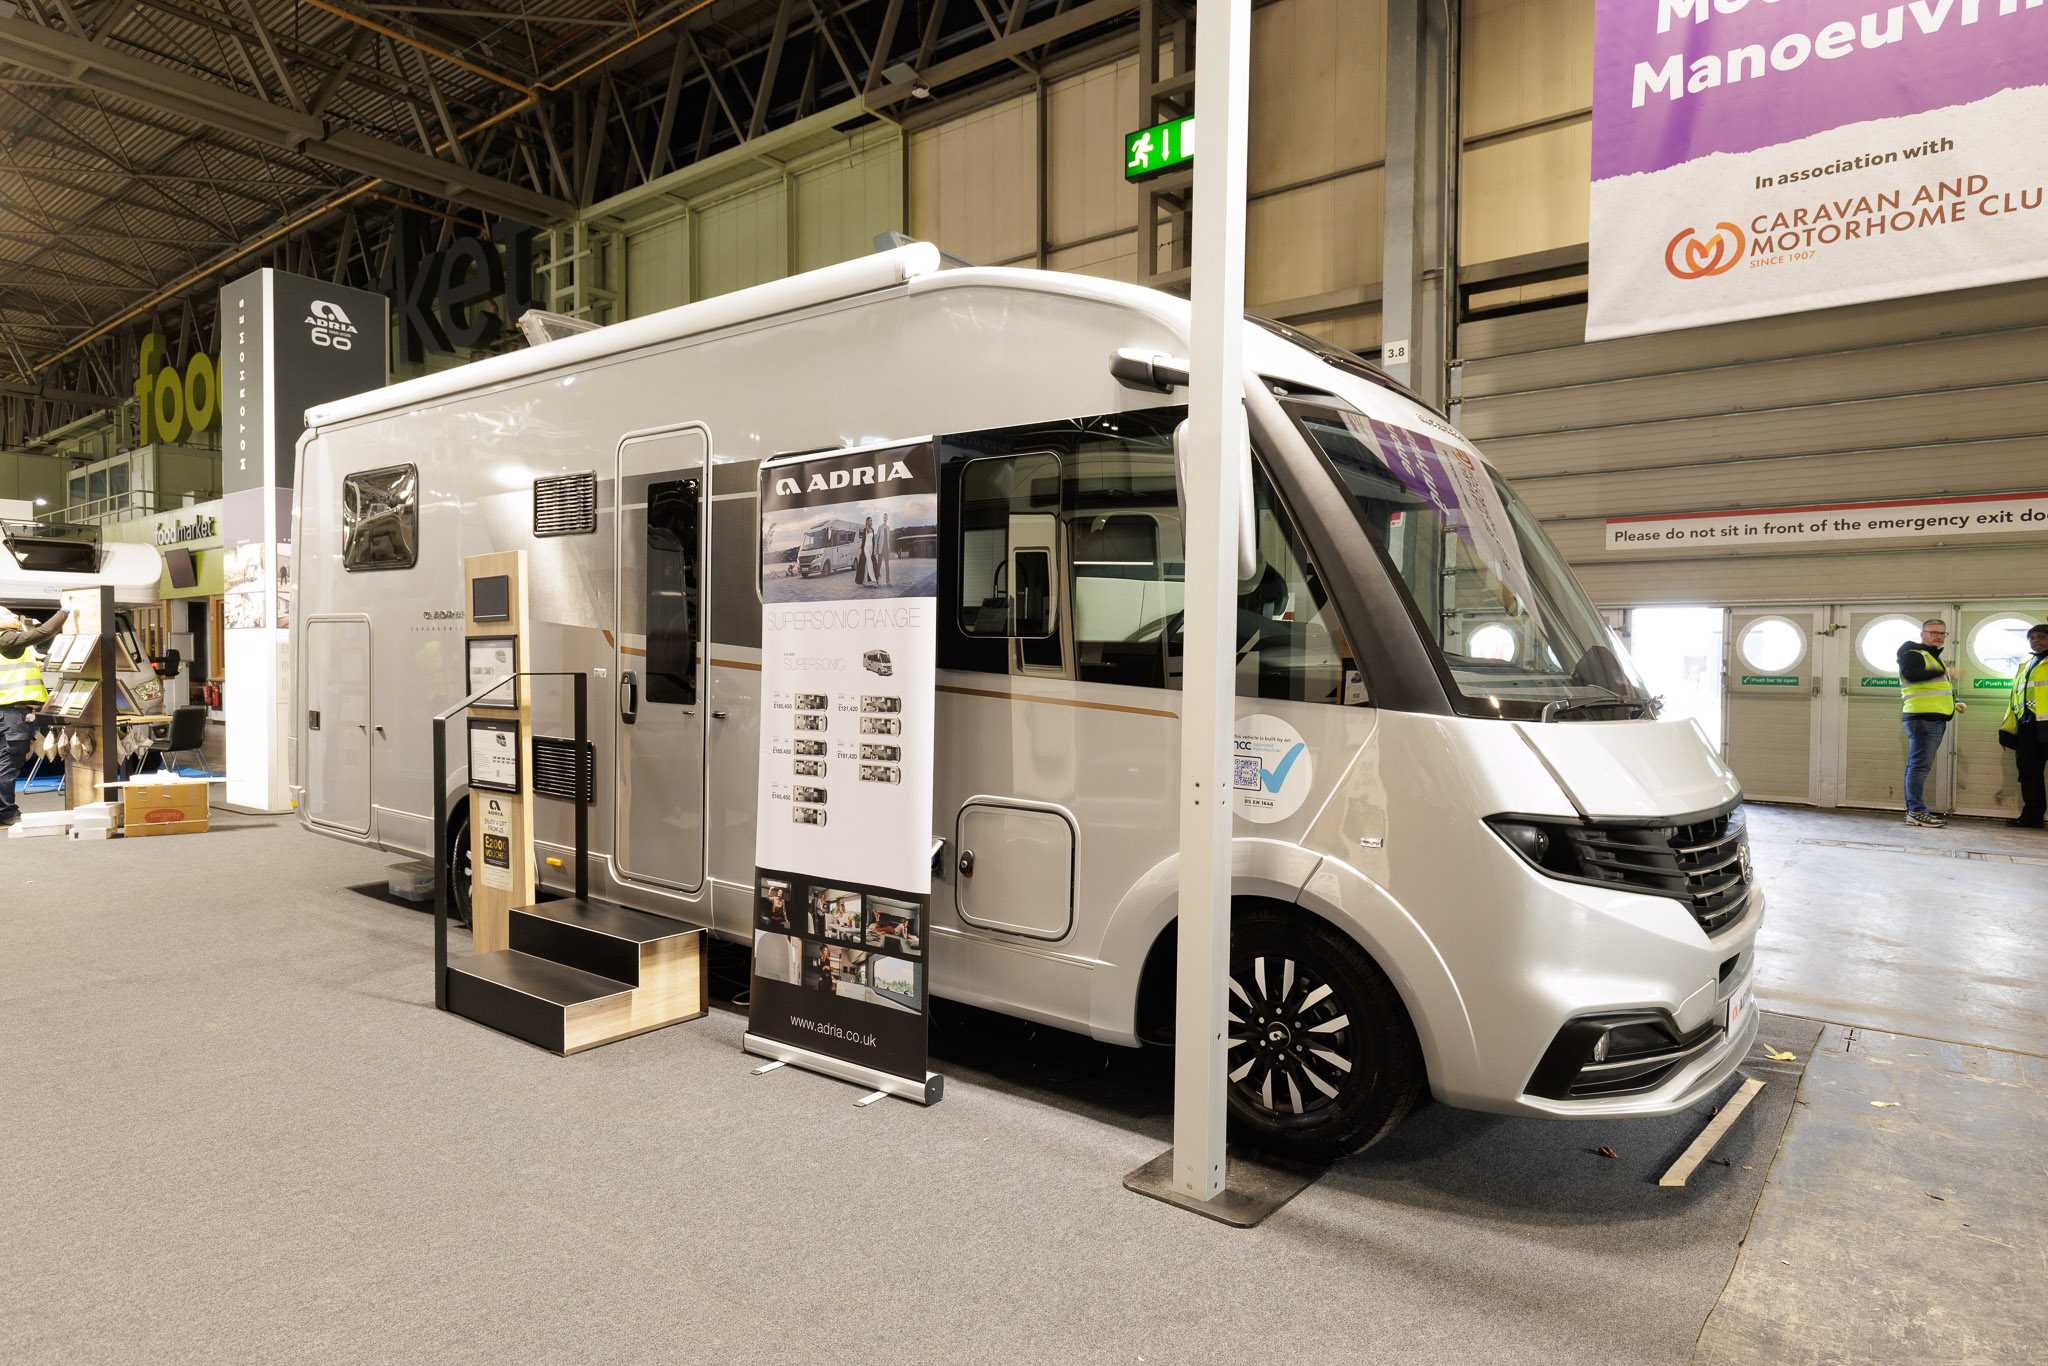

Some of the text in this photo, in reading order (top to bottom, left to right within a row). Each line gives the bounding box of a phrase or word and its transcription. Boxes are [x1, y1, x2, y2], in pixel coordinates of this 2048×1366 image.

[1755, 137, 1954, 189] In association with
[1751, 174, 1988, 234] CARAVAN AND
[1750, 200, 1966, 257] MOTORHOME
[1750, 250, 1816, 268] SINCE 1907
[304, 316, 358, 334] ADRIA
[311, 326, 352, 351] 60
[1387, 347, 1405, 359] 3.8
[135, 332, 222, 446] foo
[238, 298, 247, 471] MOTORHOMES
[806, 460, 914, 493] ADRIA
[154, 514, 215, 546] food market
[1615, 508, 2048, 542] Please do not sit in front of the emergency exit do
[767, 607, 921, 631] SUPERSONIC RANGE
[783, 657, 846, 671] SUPERSONIC
[790, 1015, 877, 1048] www.adria.co.uk
